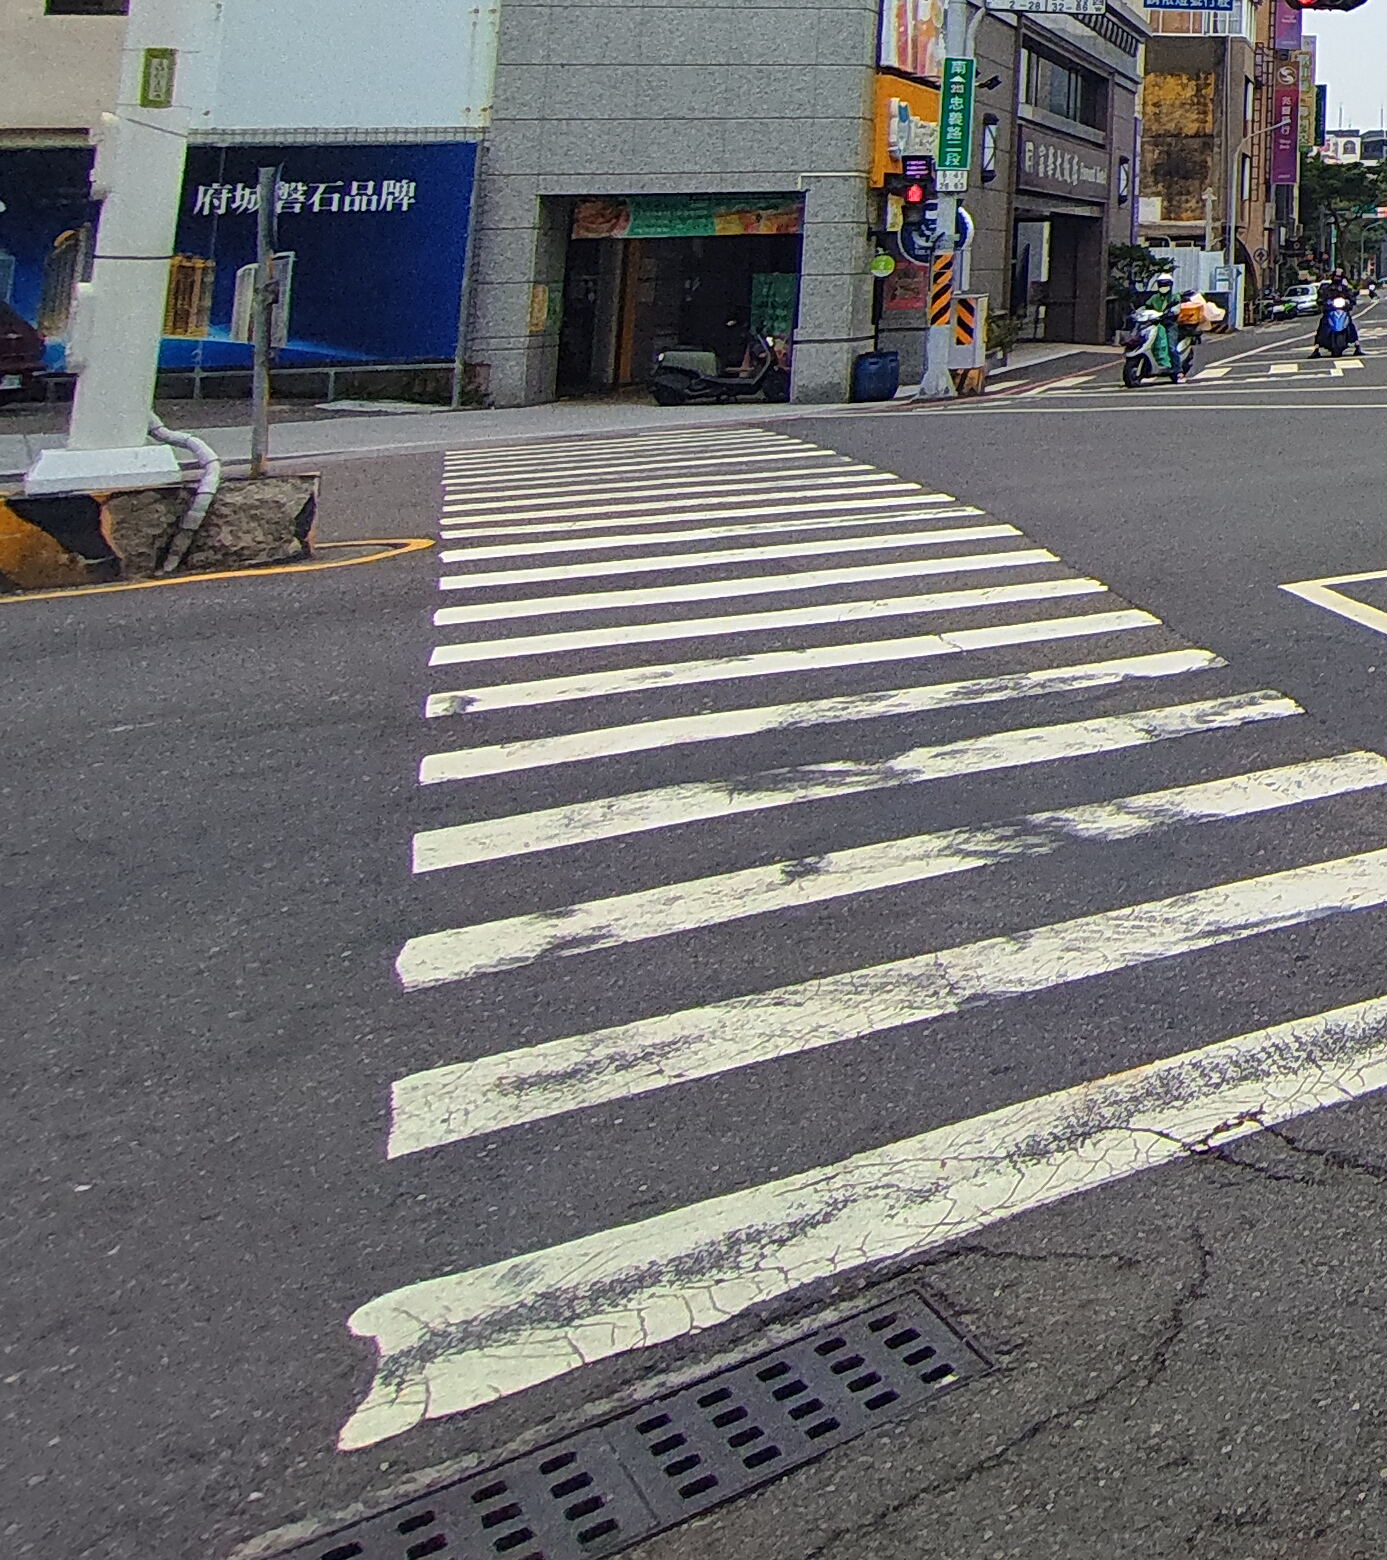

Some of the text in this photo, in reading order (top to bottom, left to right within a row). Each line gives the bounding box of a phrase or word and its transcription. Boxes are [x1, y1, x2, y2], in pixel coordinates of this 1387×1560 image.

[945, 95, 965, 166] 忠義路二段
